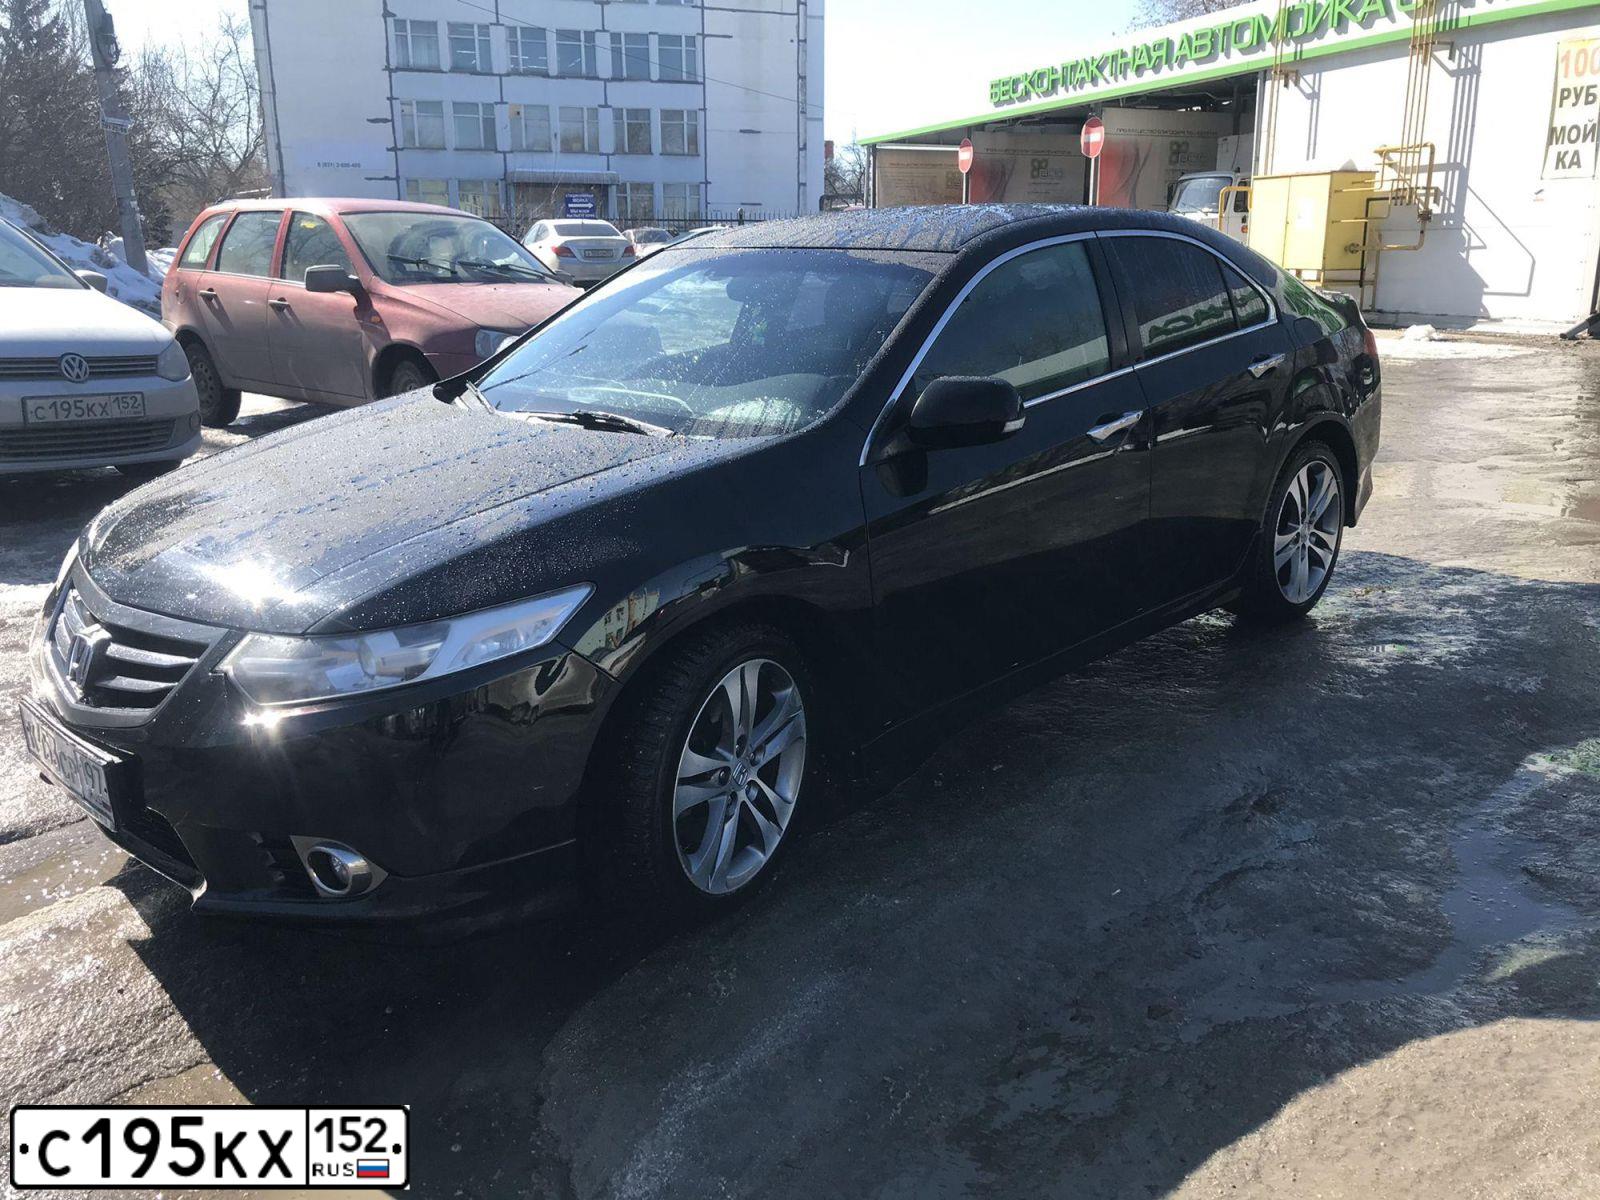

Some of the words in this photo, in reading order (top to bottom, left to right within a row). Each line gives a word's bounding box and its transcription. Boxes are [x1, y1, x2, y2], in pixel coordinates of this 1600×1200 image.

[989, 37, 1169, 103] БЕСКОНТАКТНАЯ
[1561, 47, 1600, 79] 100
[1558, 84, 1598, 109] РУБ
[1550, 118, 1597, 146] МОЙ
[1554, 149, 1582, 171] КА
[34, 400, 110, 420] С195КХ
[112, 395, 139, 410] 152
